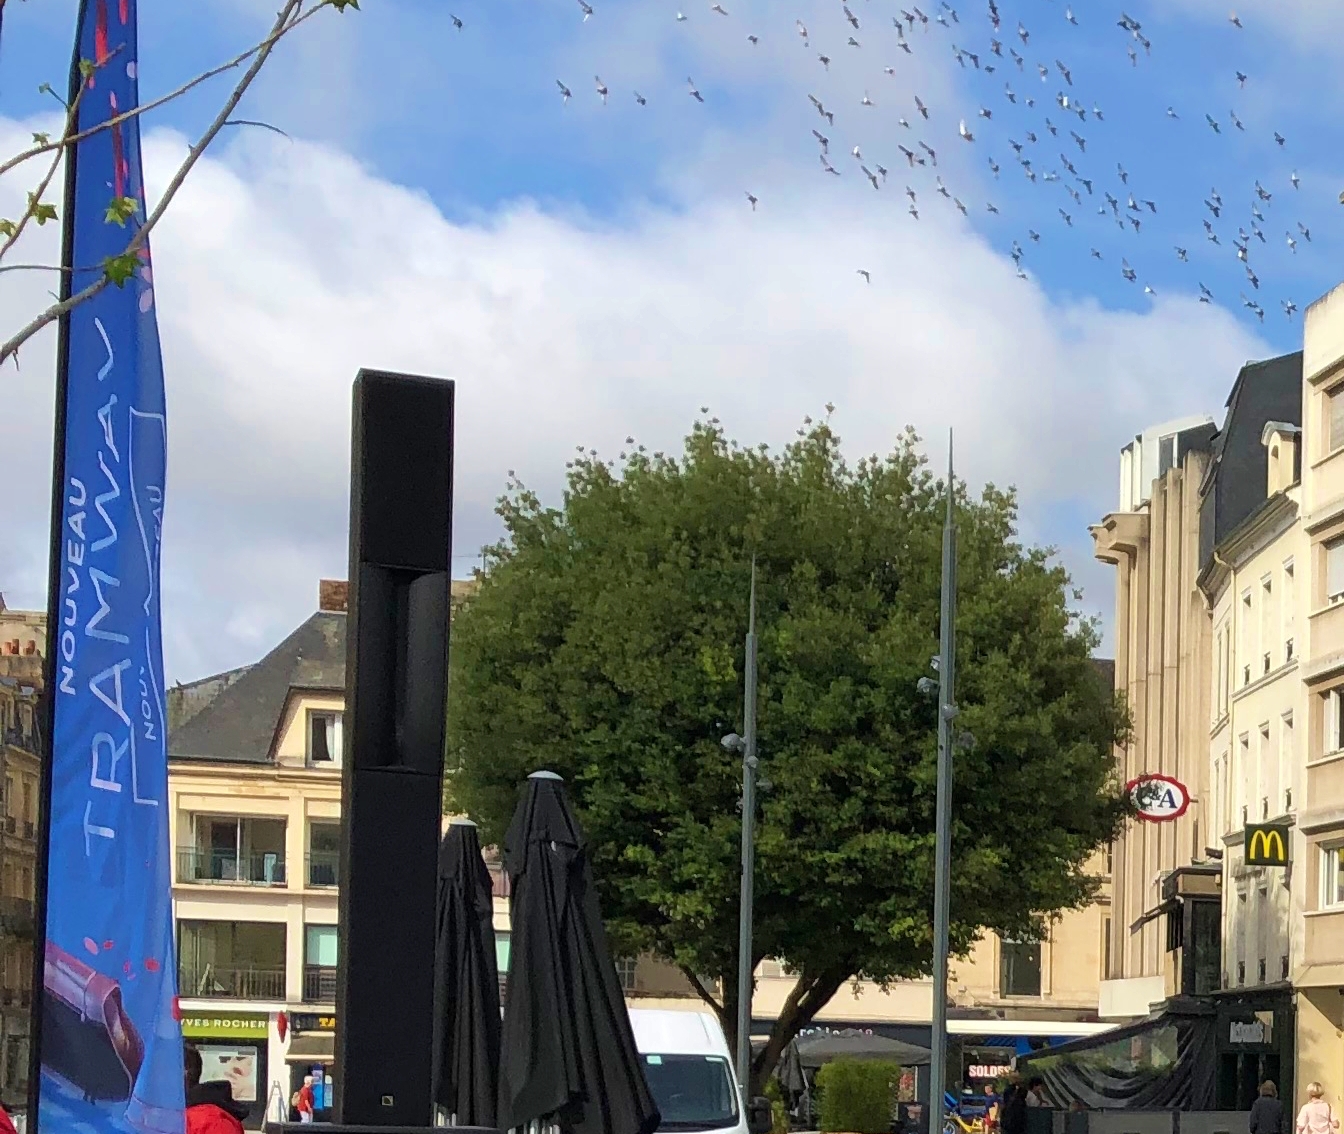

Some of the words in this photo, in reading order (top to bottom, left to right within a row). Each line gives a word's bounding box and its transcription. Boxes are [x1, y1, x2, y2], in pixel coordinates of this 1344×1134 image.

[60, 477, 88, 696] NOUVEAU
[82, 317, 131, 857] TRAMWAY
[213, 1019, 267, 1029] ROCHER
